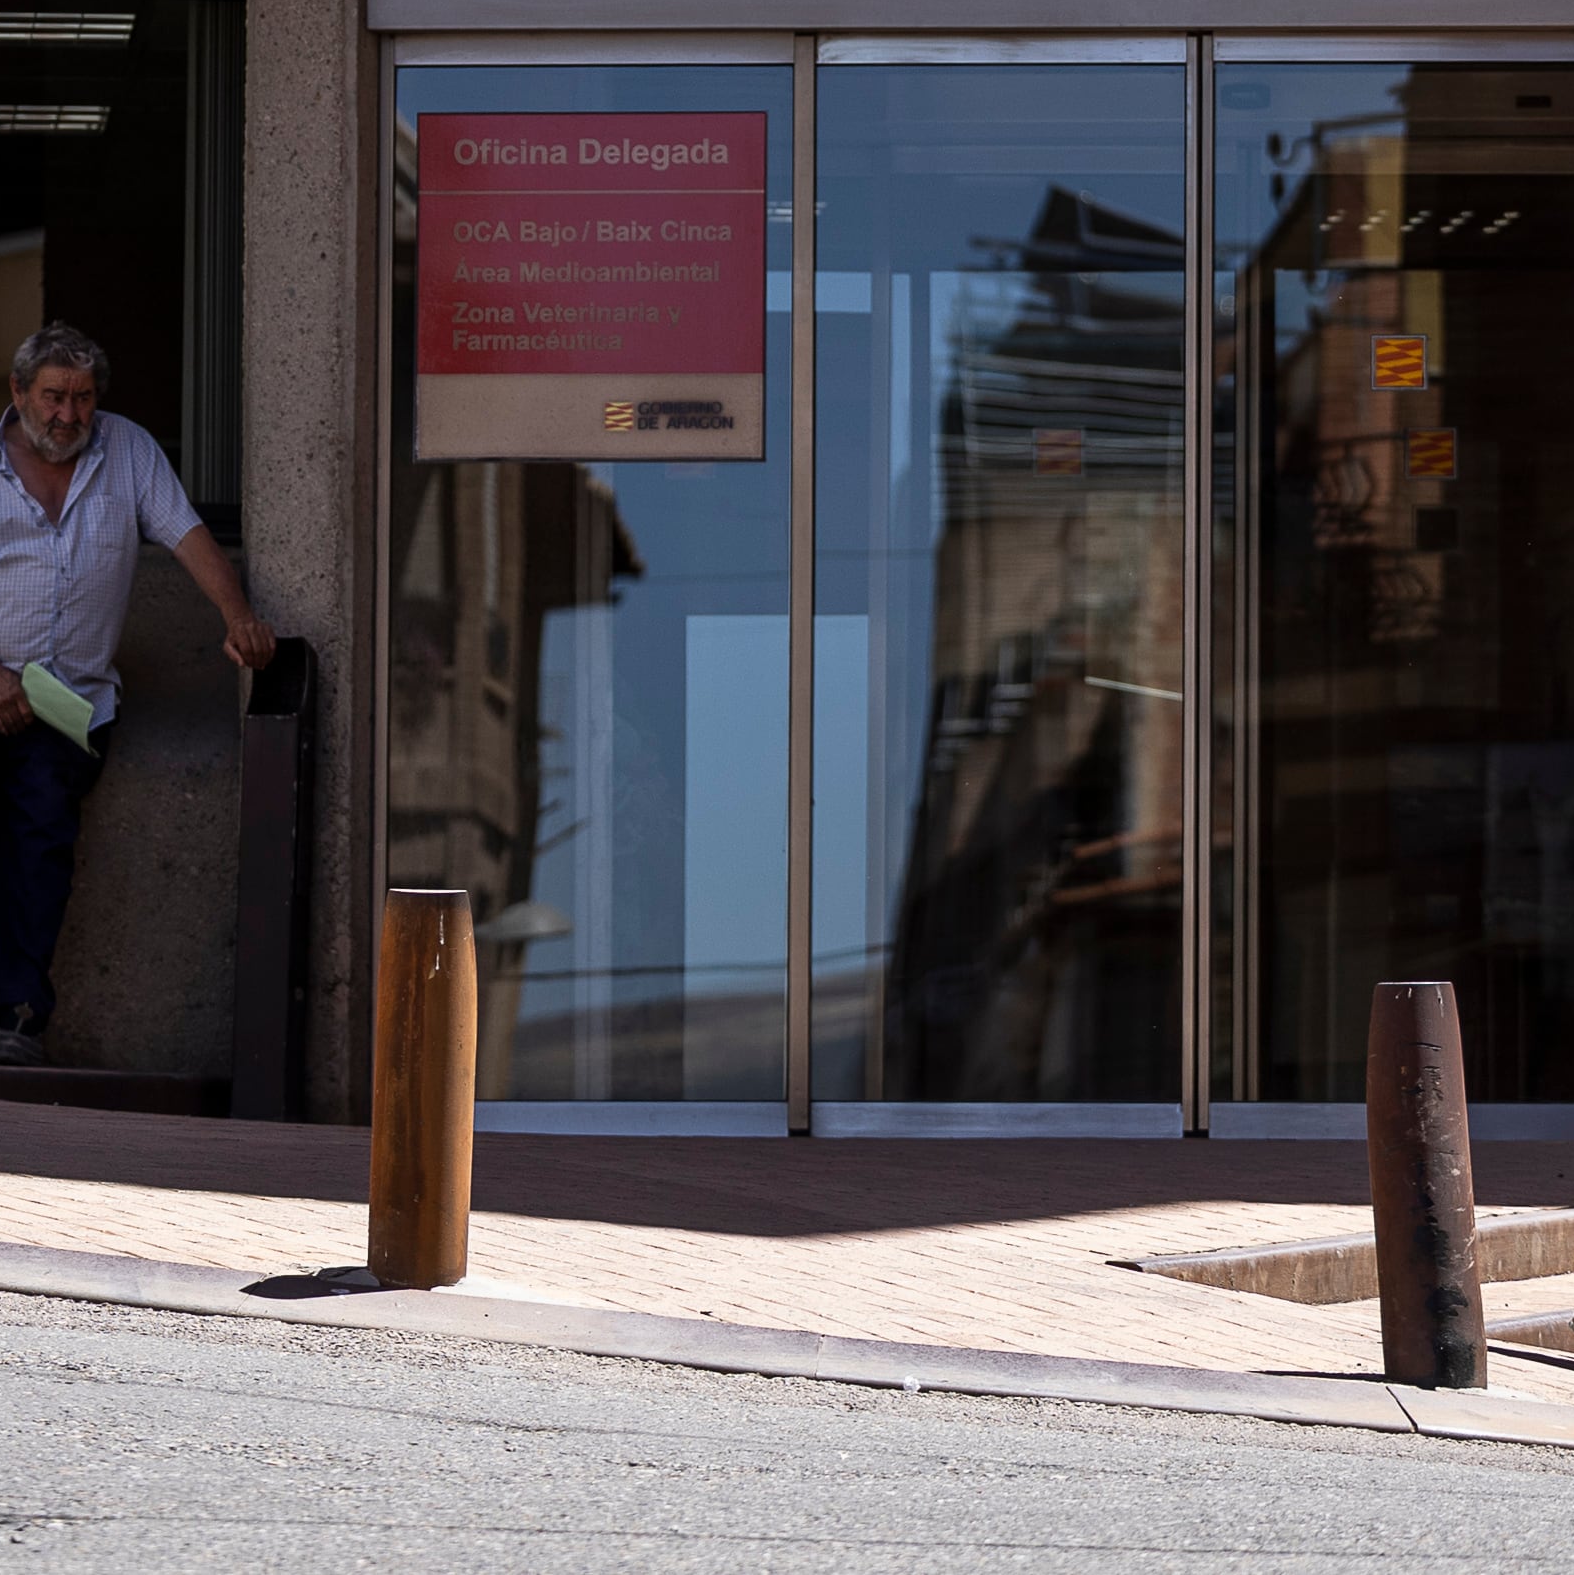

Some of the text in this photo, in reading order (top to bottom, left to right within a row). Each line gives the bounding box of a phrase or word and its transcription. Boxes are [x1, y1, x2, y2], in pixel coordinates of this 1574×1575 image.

[453, 138, 730, 171] Oficina Delegada
[453, 221, 512, 243] OCA
[520, 221, 576, 247] Bajo
[596, 220, 652, 242] Baix
[660, 220, 733, 242] Cinca
[452, 258, 720, 283] Área Medioambiental
[451, 301, 683, 328] Zona Veterinaria y
[451, 329, 623, 351] Farmacéutica
[637, 401, 723, 415] GOBIERNO
[637, 415, 734, 430] DE ARAGON
